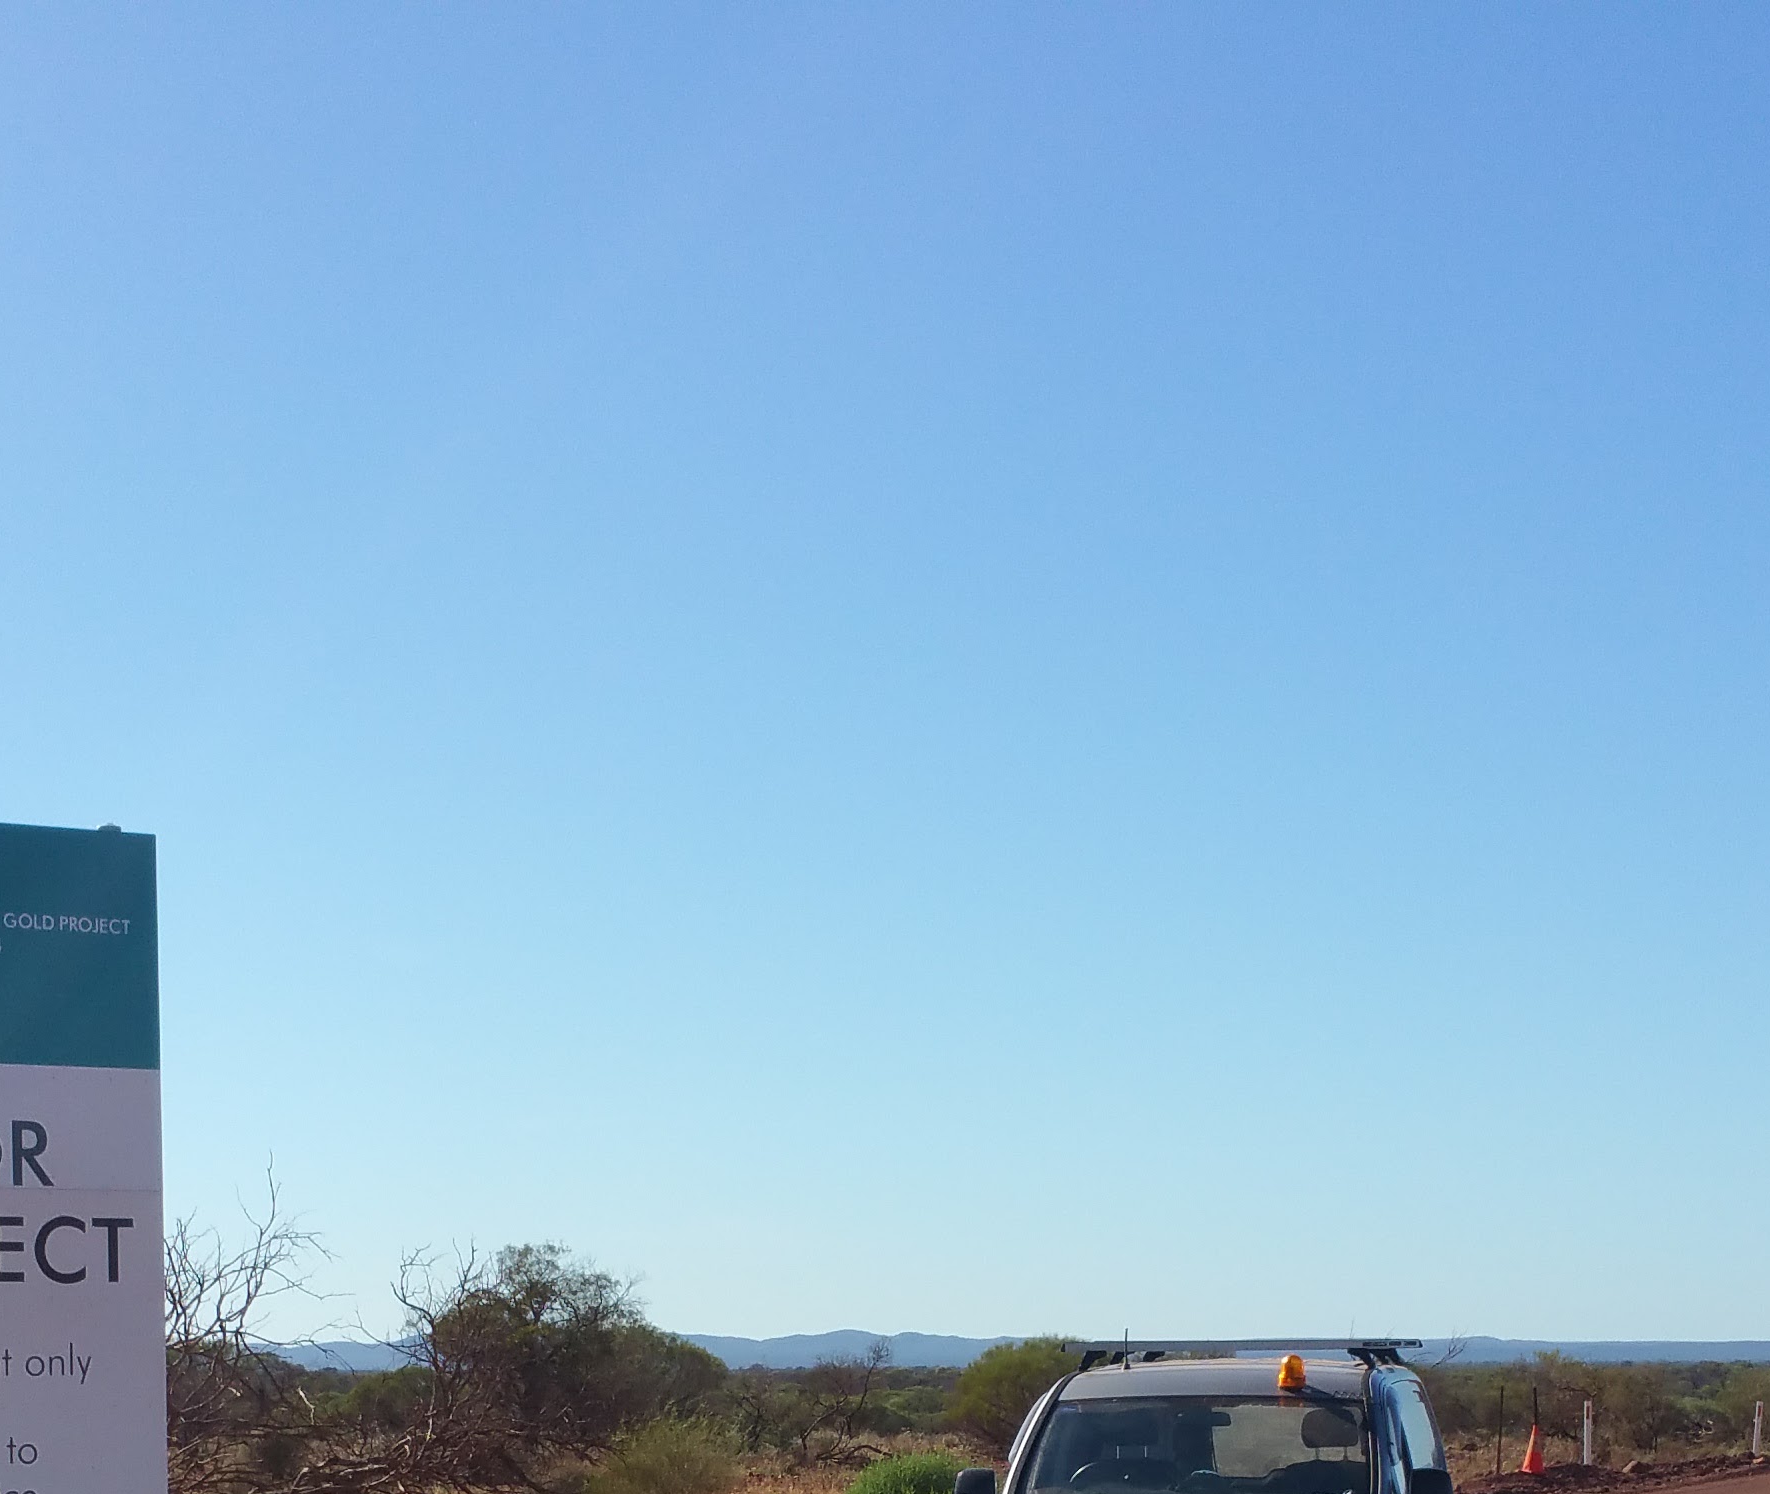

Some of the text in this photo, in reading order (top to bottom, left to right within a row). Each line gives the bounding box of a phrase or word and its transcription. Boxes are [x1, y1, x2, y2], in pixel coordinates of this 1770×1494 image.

[3, 911, 55, 931] GOLD
[59, 915, 131, 935] PROJECT
[24, 1342, 93, 1384] only
[6, 1436, 39, 1466] to
